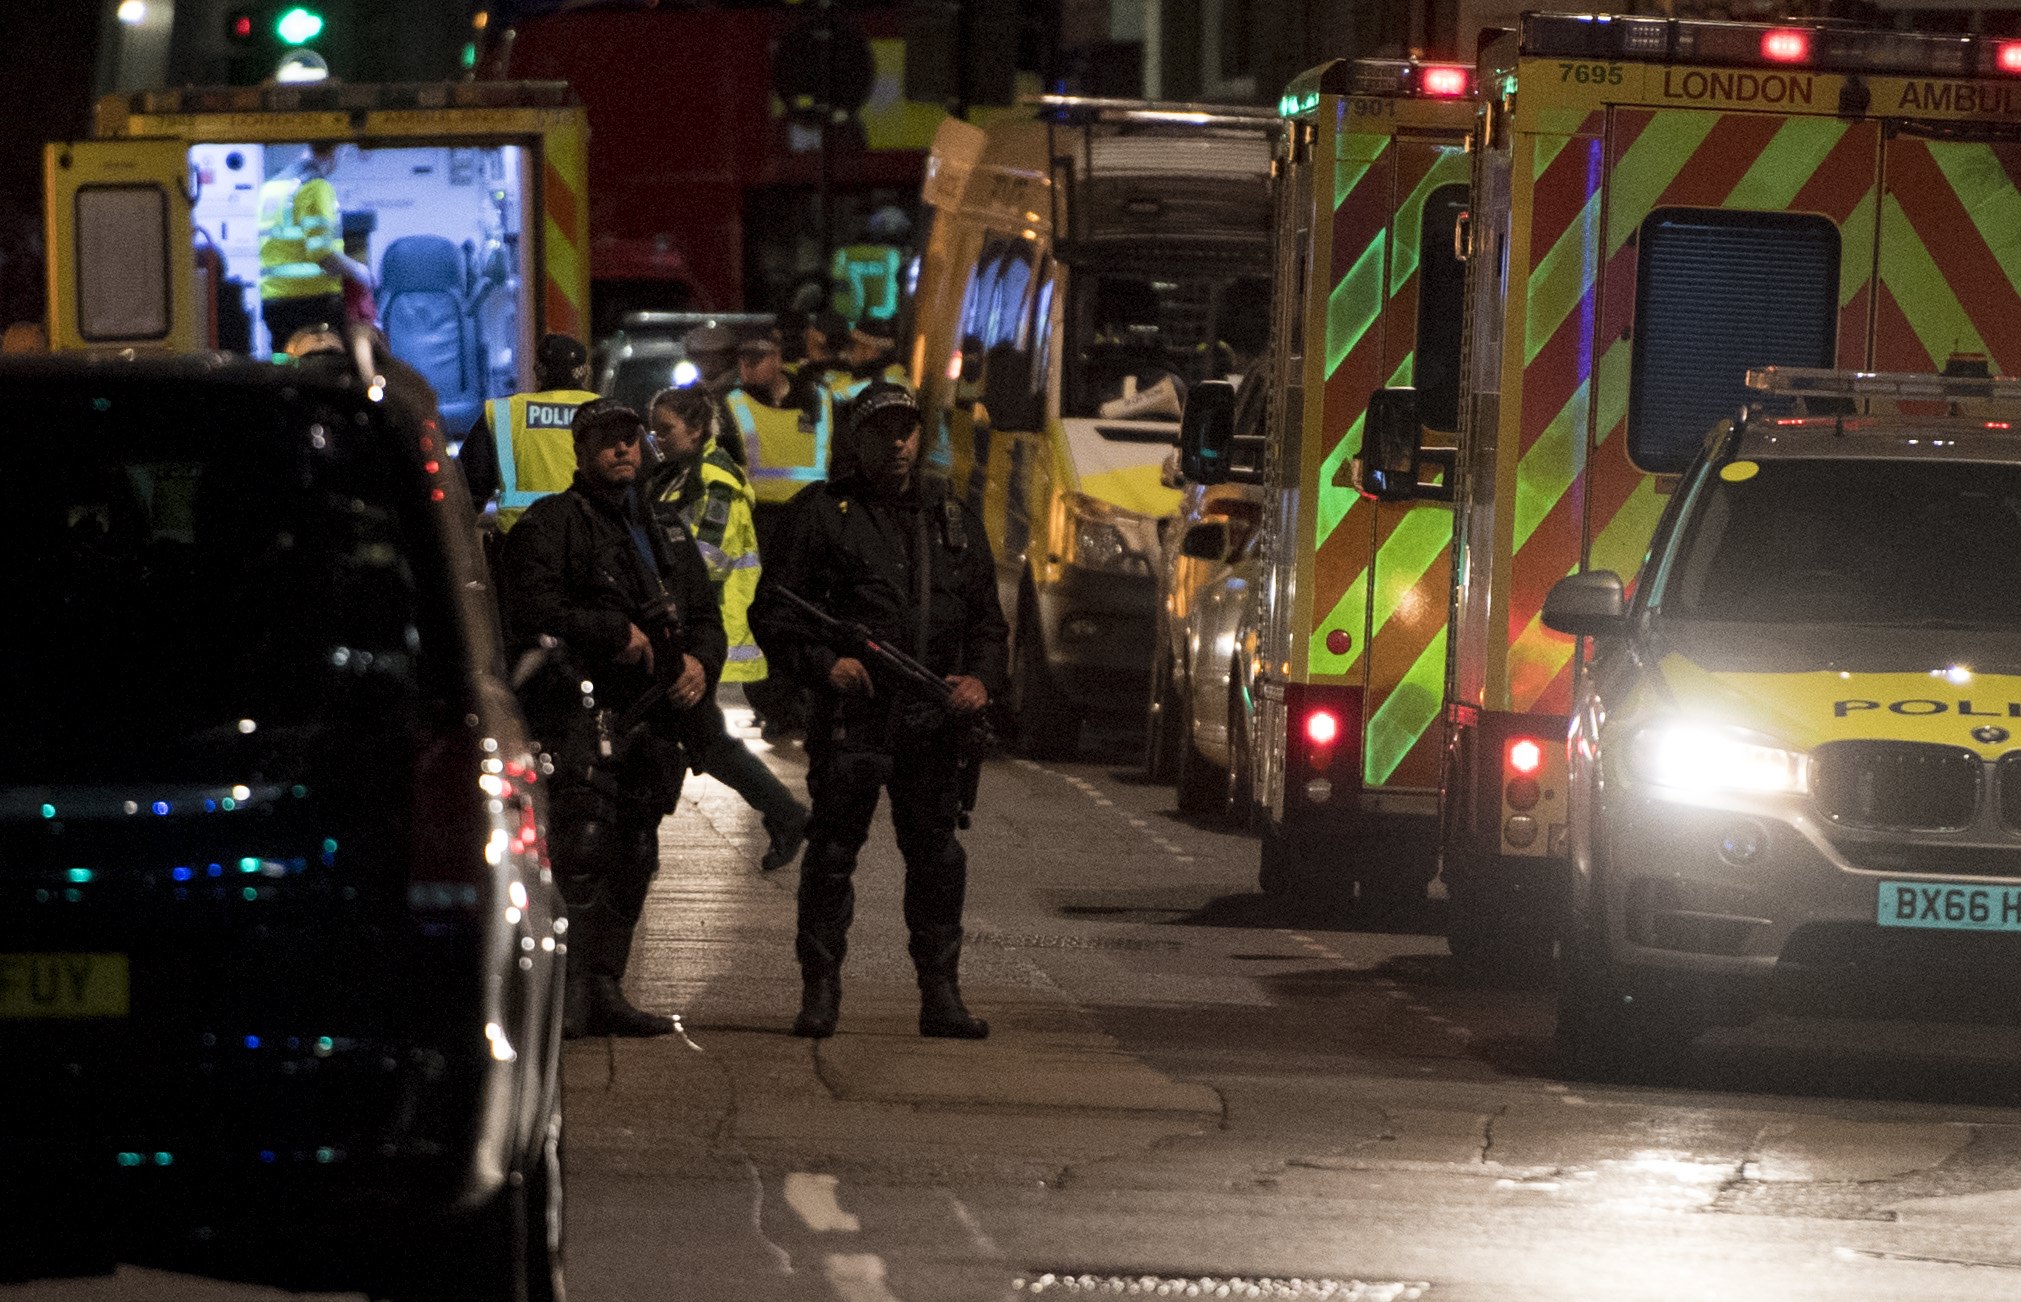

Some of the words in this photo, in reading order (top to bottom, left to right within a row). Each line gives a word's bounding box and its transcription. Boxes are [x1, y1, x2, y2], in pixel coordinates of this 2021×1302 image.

[1558, 63, 1623, 86] 7695
[1663, 70, 1813, 104] LONDON
[1896, 887, 1989, 922] BX66
[2002, 891, 2021, 923] H
